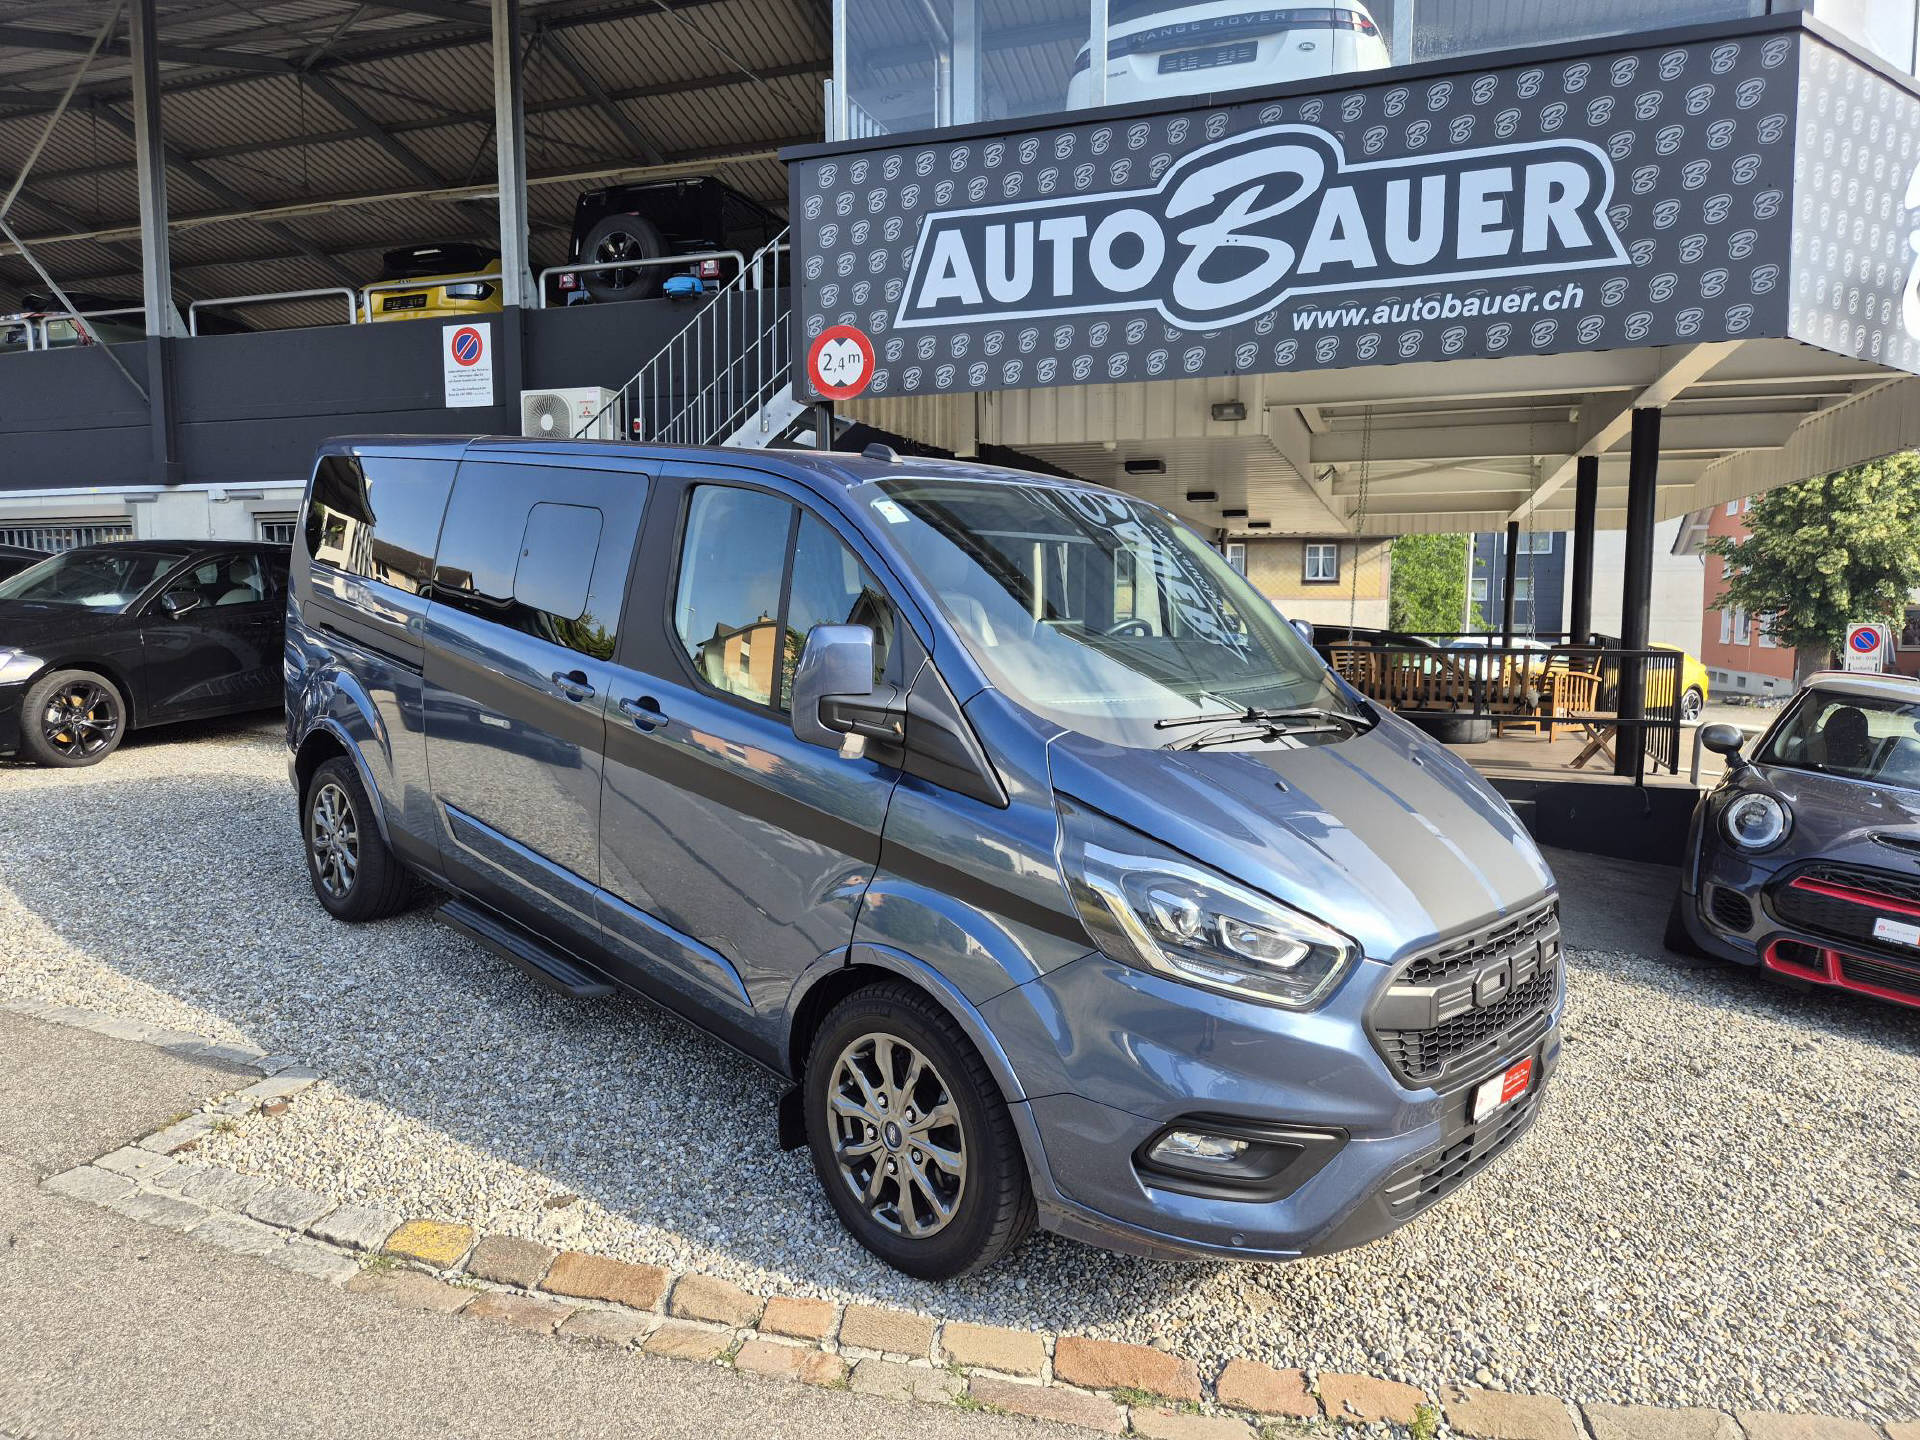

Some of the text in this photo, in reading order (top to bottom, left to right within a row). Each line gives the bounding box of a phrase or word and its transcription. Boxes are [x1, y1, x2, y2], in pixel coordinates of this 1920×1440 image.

[1132, 11, 1288, 43] RANGE ROVER
[1293, 283, 1583, 331] www.autobauer.ch
